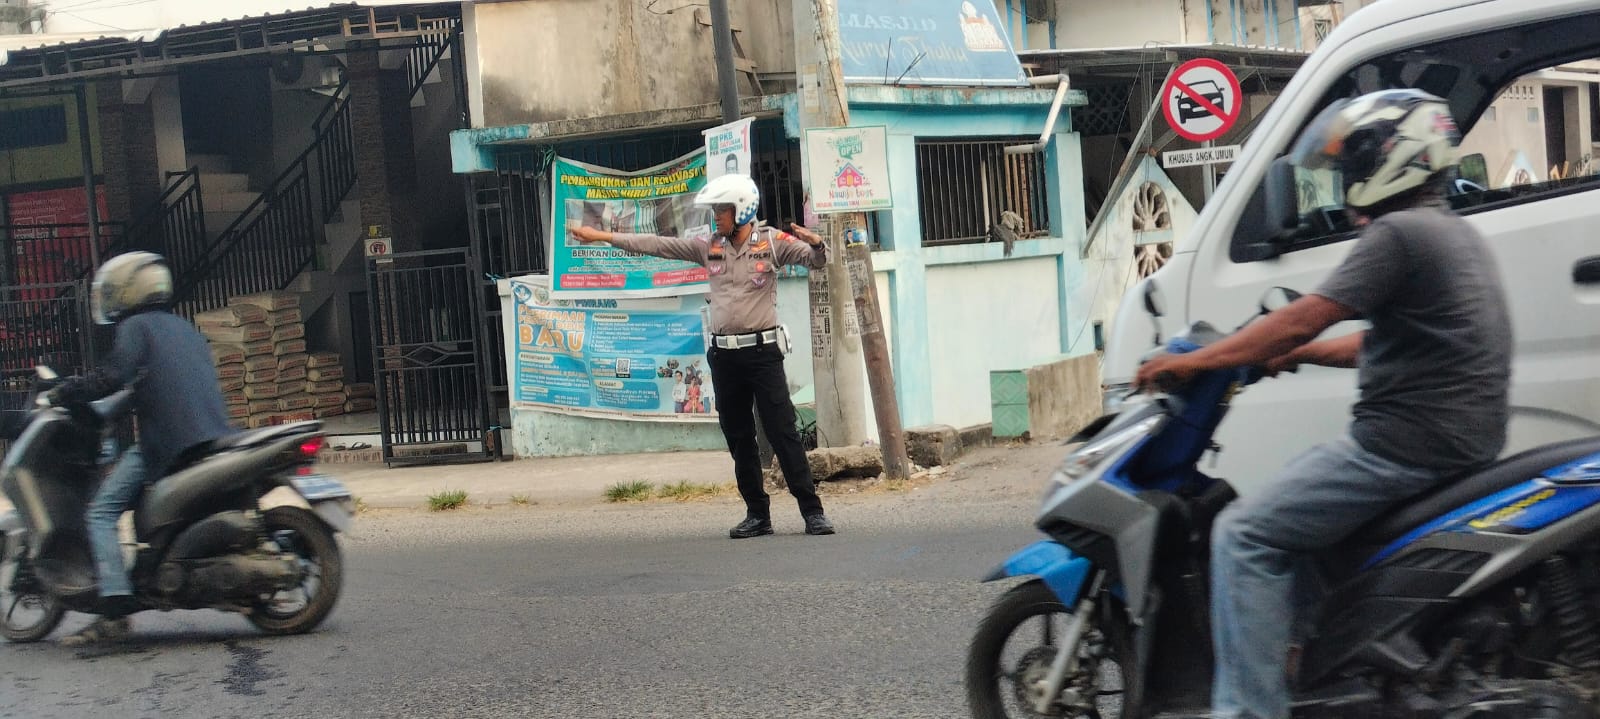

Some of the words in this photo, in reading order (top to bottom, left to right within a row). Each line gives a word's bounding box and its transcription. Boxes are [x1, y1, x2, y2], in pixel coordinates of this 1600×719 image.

[720, 131, 733, 141] PKB
[841, 144, 862, 156] OPEN
[1168, 152, 1193, 165] KHUSUS
[630, 176, 650, 187] DAN
[572, 249, 609, 258] BERIKAN
[518, 324, 584, 352] BARU
